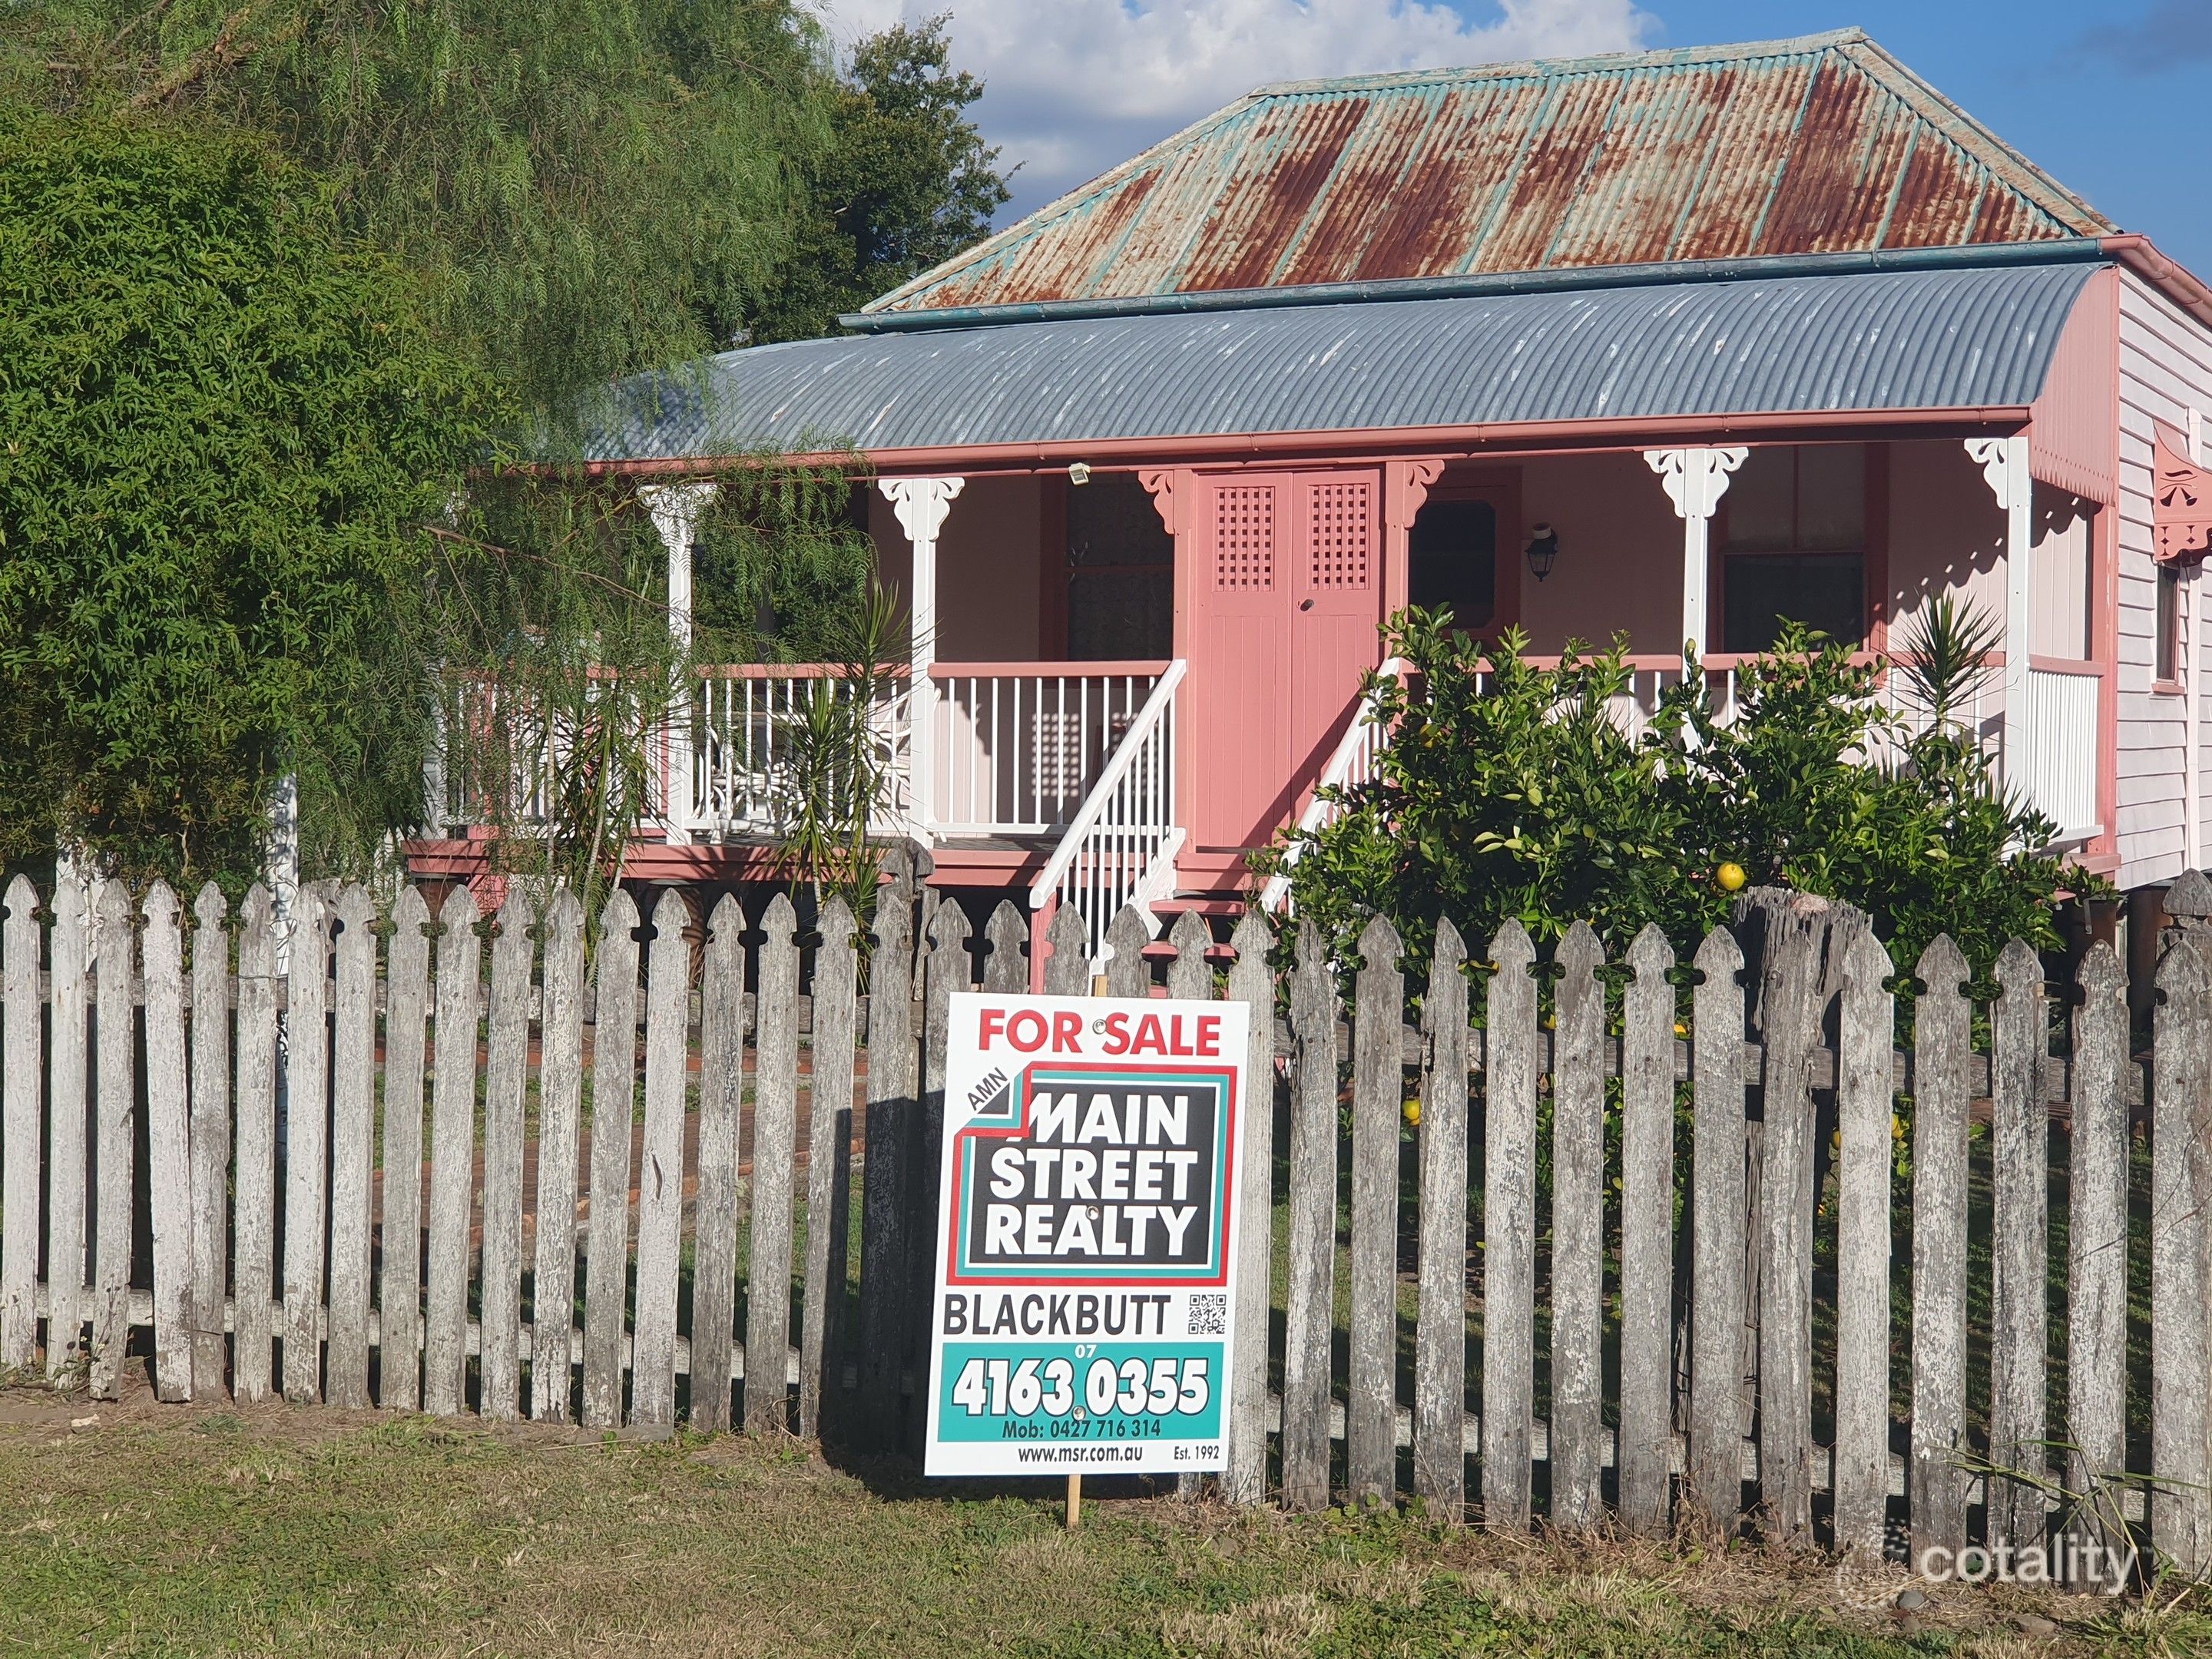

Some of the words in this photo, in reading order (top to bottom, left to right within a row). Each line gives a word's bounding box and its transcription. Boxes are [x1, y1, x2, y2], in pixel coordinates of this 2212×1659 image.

[979, 1008, 1083, 1053] FOR
[1102, 1012, 1221, 1057] SALE
[967, 1066, 1008, 1111] AMN
[1006, 1092, 1189, 1144] MAIN
[989, 1147, 1198, 1200] STREET
[985, 1203, 1198, 1256] REALTY
[943, 1294, 1171, 1335] BLACKBUTT
[1075, 1344, 1097, 1359] 07
[952, 1357, 1075, 1416] 4163
[1084, 1357, 1210, 1416] 0355
[1002, 1421, 1044, 1439] Mob:
[1050, 1420, 1091, 1439] 0427
[1097, 1420, 1125, 1437] 716
[1131, 1419, 1161, 1436] 314
[1018, 1446, 1143, 1462] www.msr.com.au
[1174, 1446, 1190, 1460] Est.
[1195, 1445, 1220, 1459] 1992
